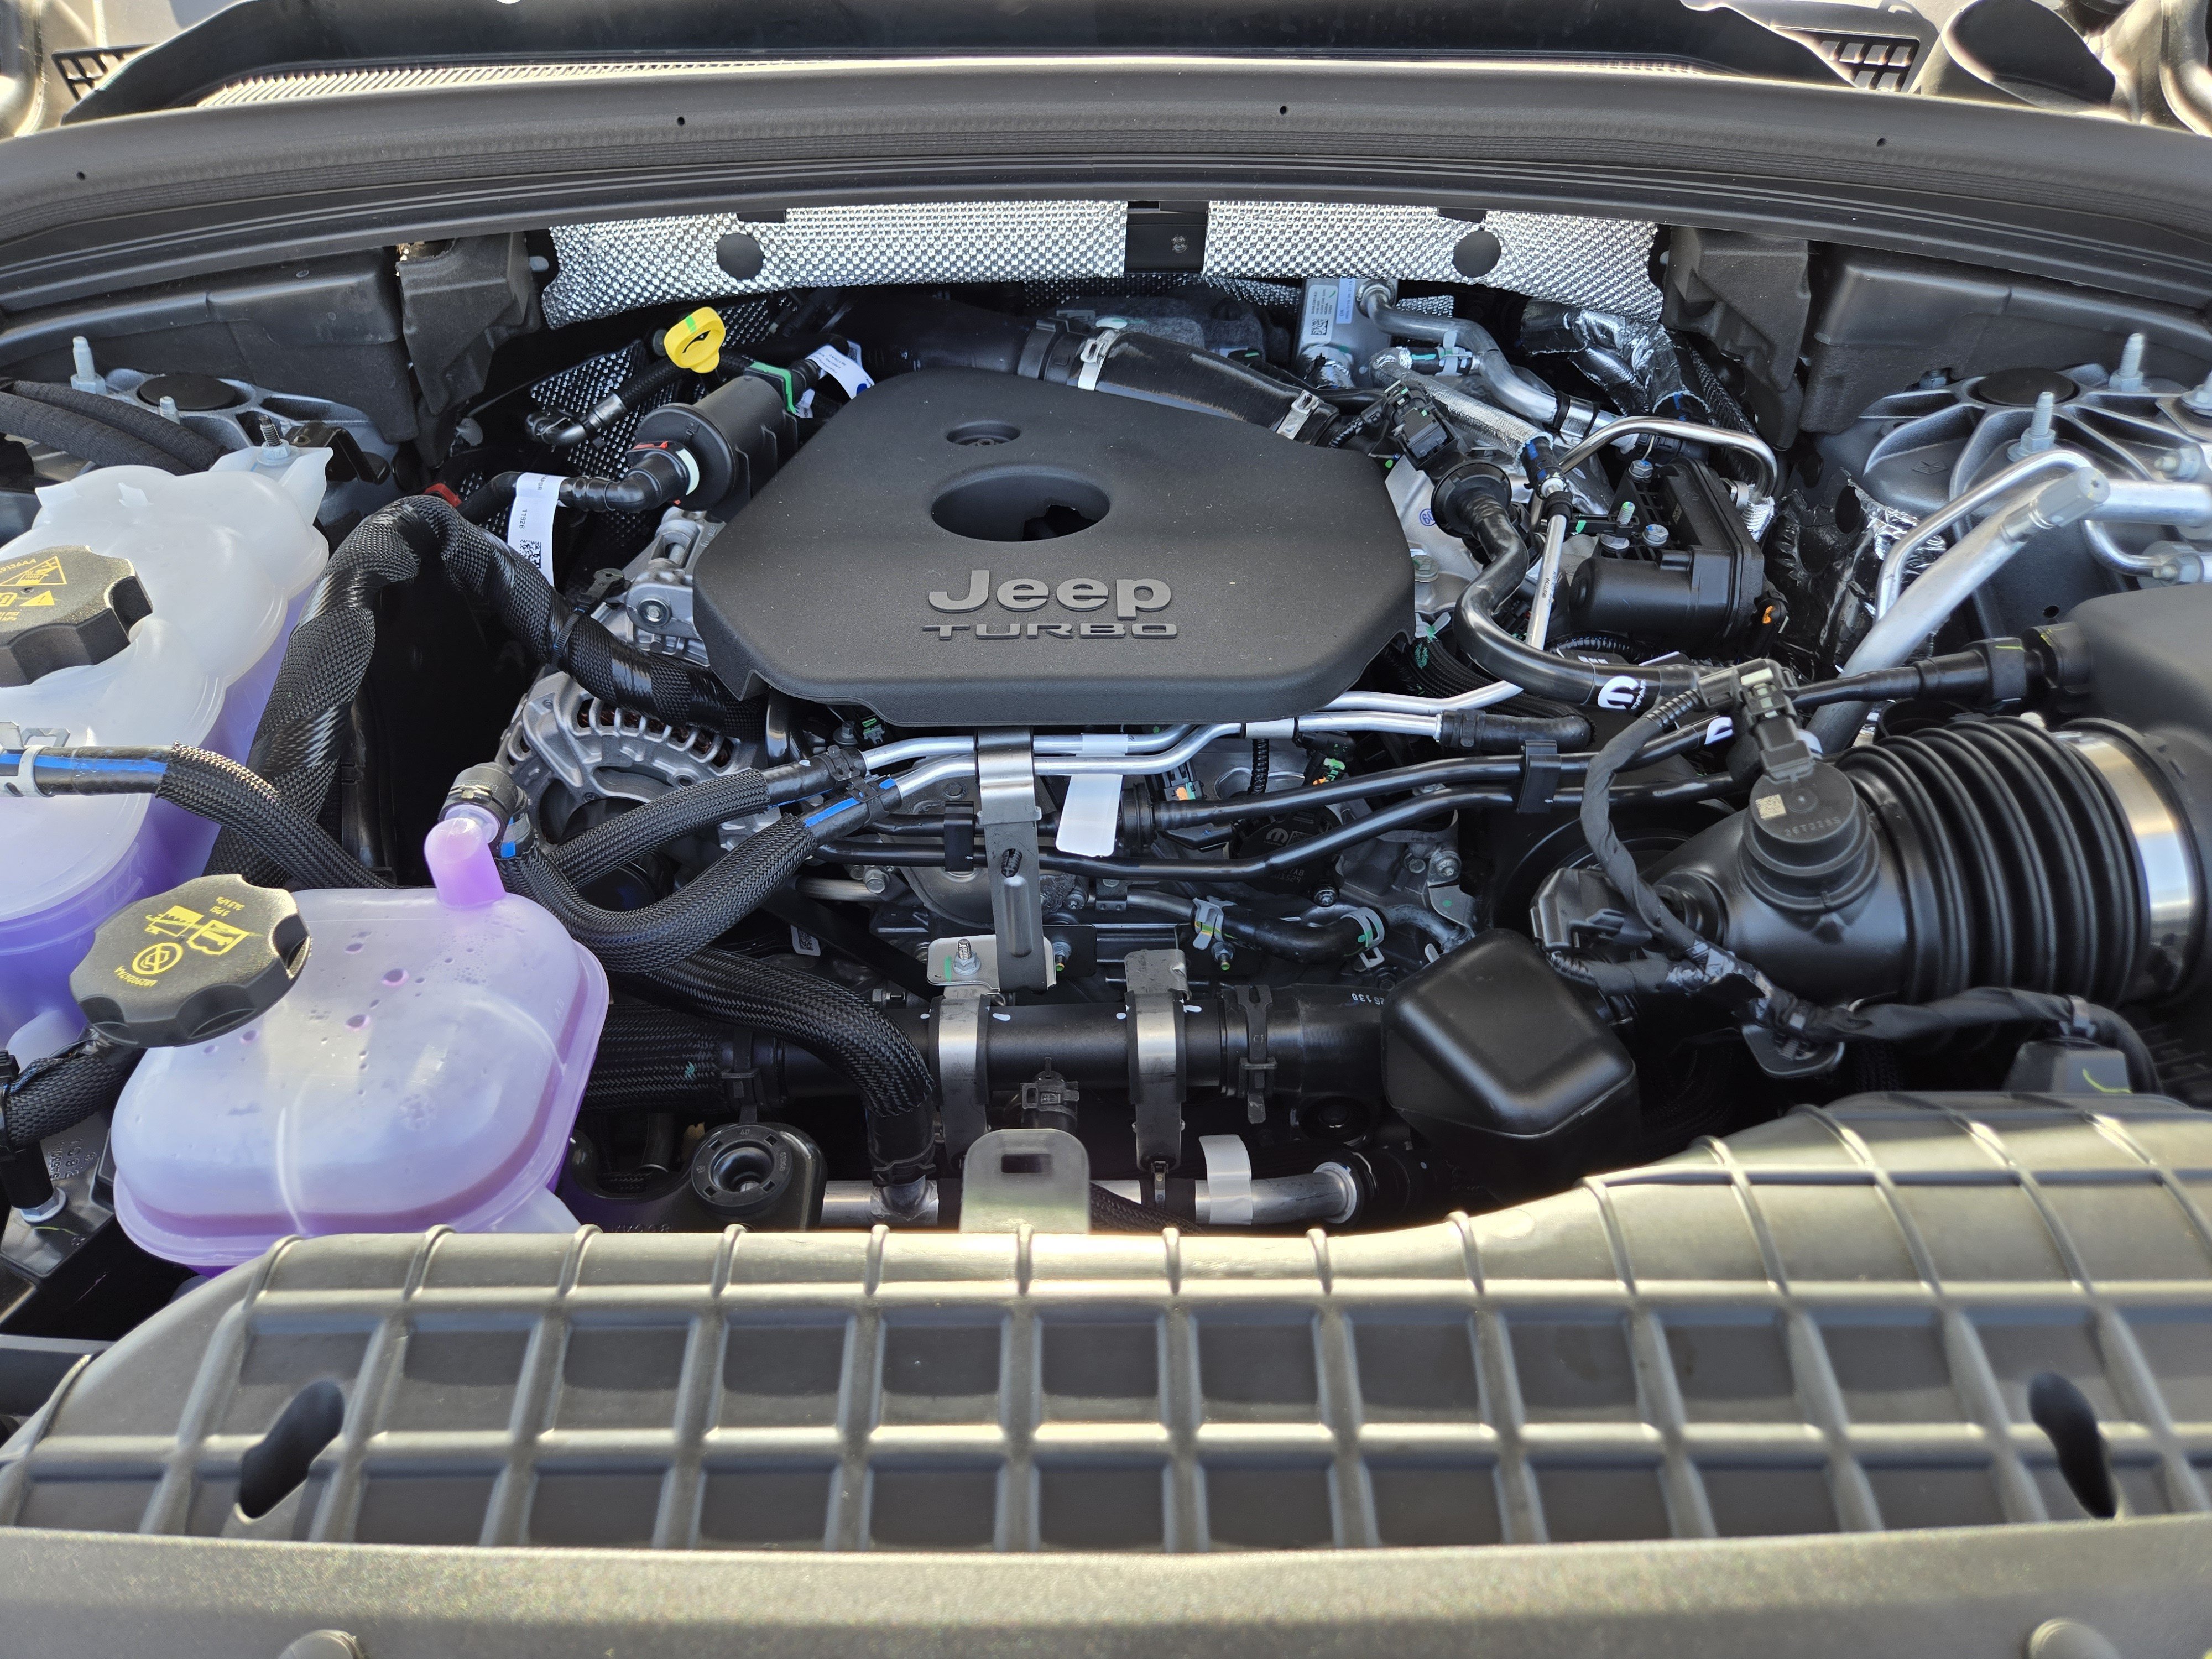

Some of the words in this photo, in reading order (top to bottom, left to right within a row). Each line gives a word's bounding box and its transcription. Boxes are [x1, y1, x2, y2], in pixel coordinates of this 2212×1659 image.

[519, 508, 528, 529] 11926
[928, 570, 1172, 620] Jeep
[922, 623, 1178, 640] TURBO
